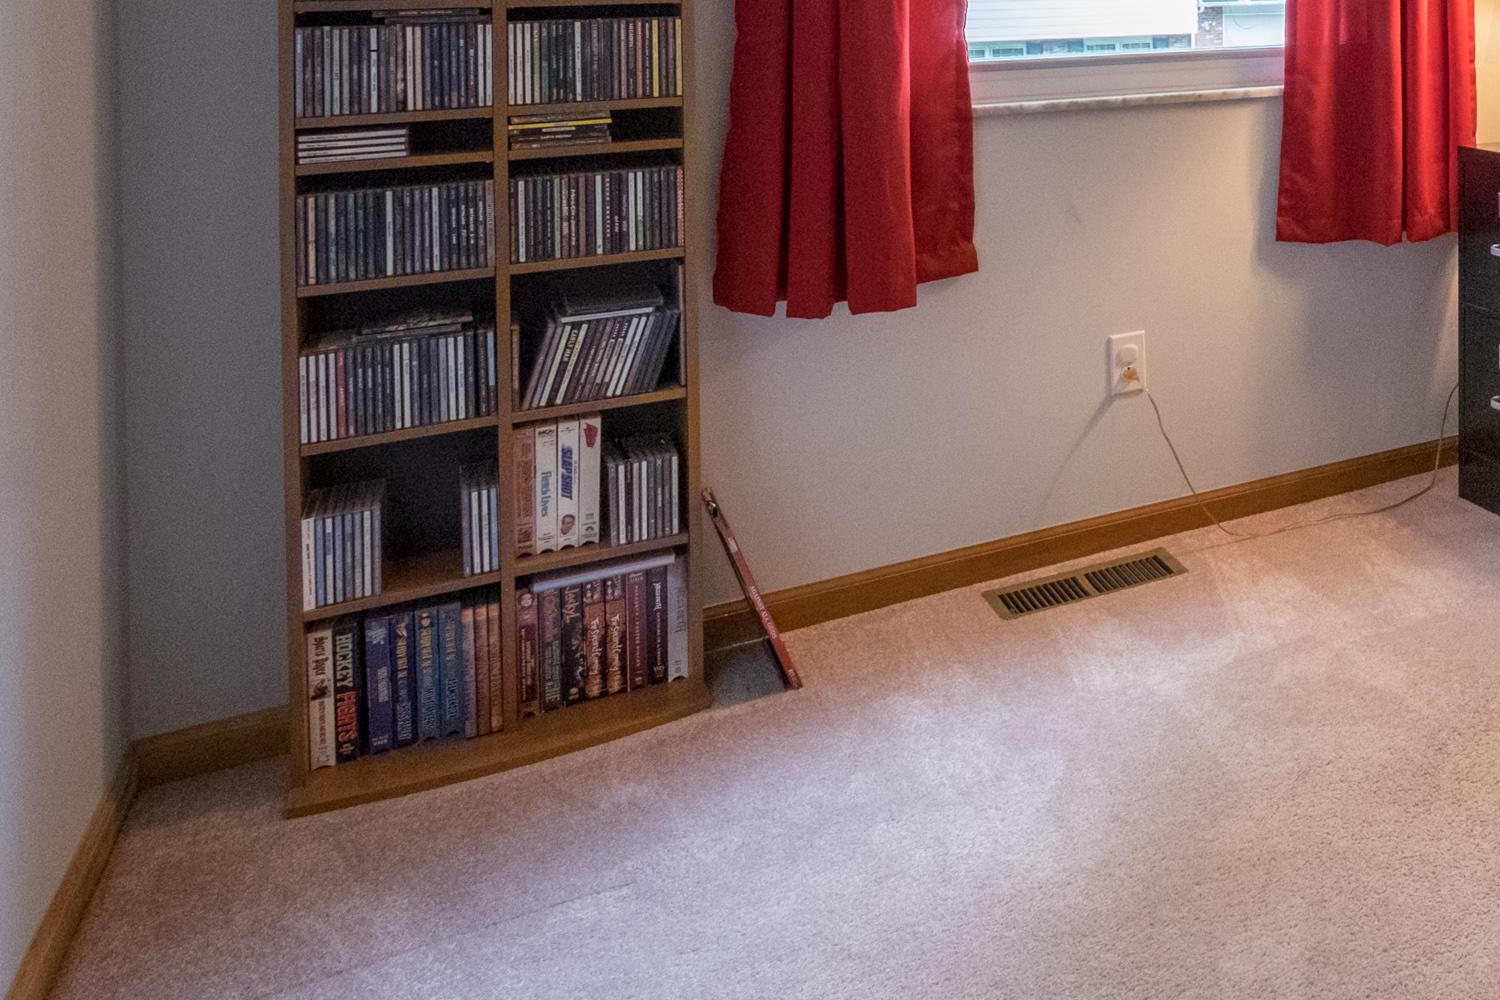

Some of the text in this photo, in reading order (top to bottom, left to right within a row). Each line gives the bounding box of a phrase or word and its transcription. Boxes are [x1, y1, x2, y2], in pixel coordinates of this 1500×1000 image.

[561, 445, 573, 500] SLAP SHOT
[541, 496, 552, 518] Lives
[335, 633, 358, 742] HOCKEY FIGHTS
